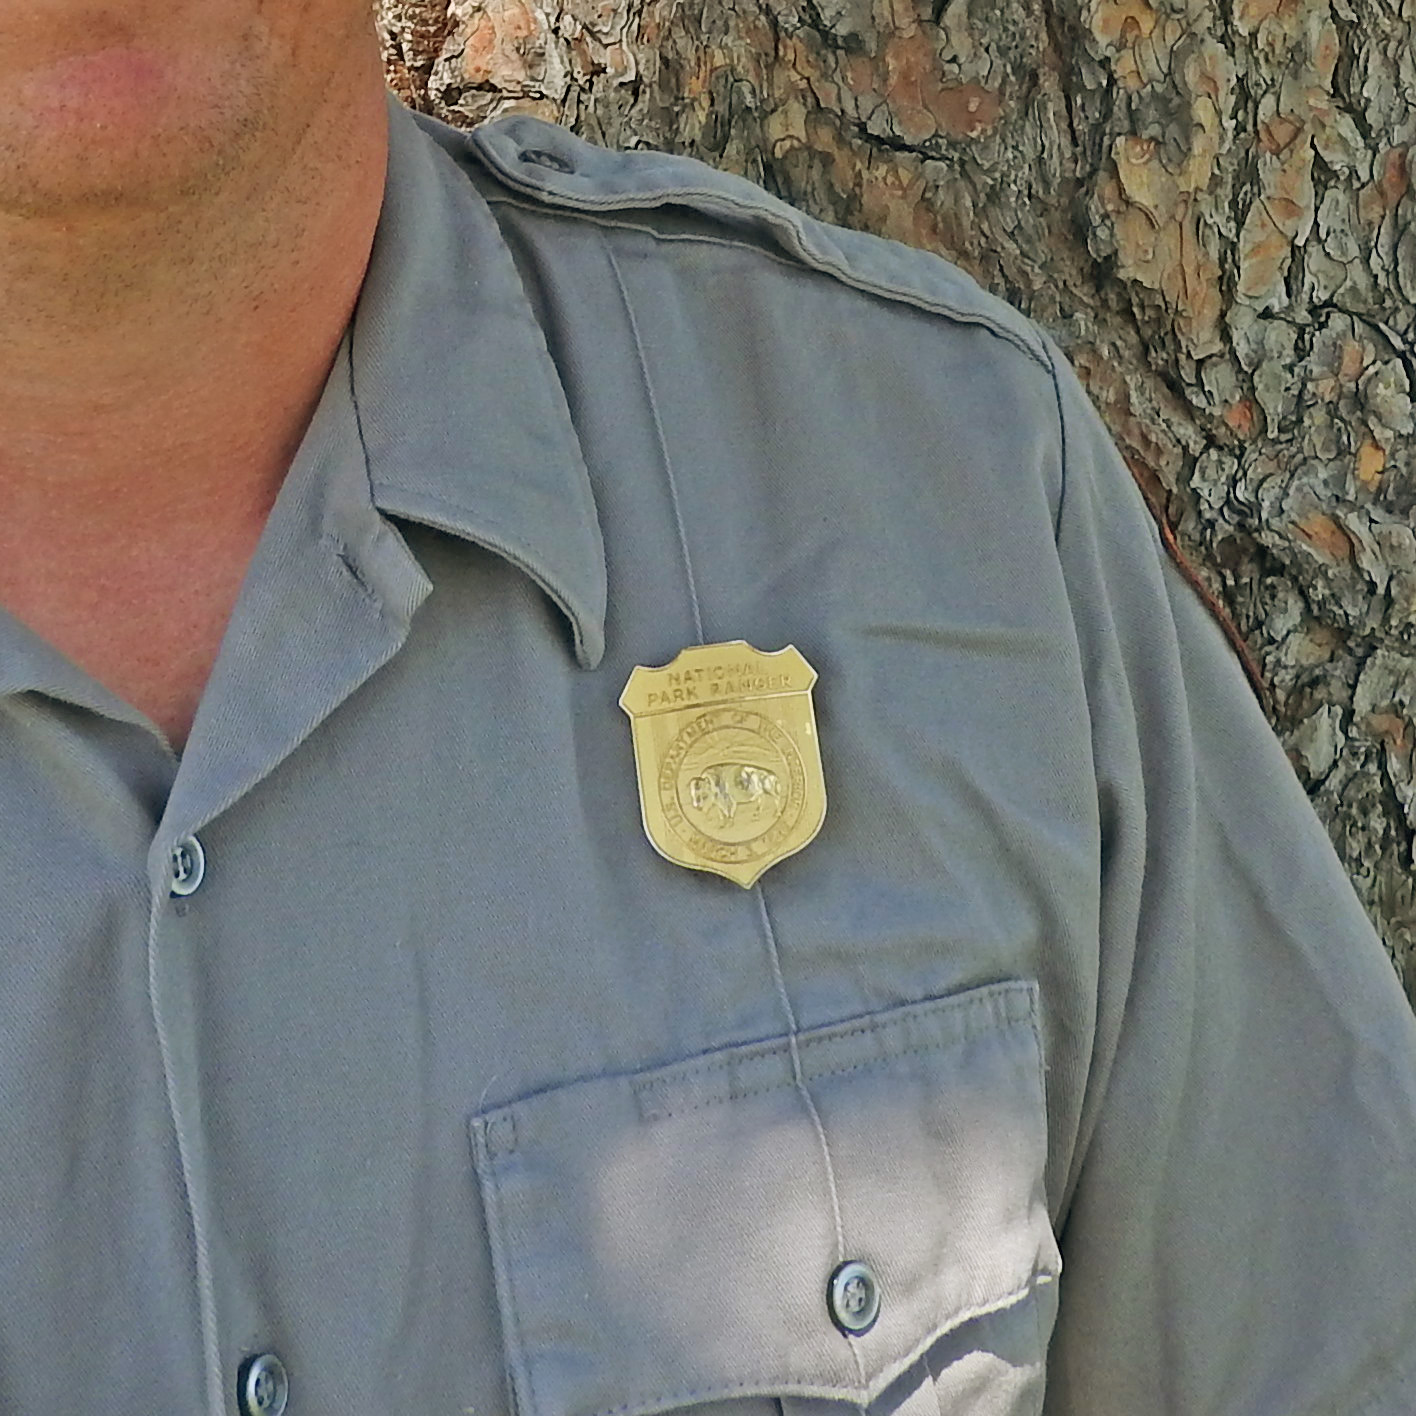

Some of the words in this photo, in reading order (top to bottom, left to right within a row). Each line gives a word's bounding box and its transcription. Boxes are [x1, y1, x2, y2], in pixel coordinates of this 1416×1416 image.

[667, 662, 764, 686] NATIONAL
[647, 686, 699, 707] PARK
[710, 674, 792, 695] RANGER
